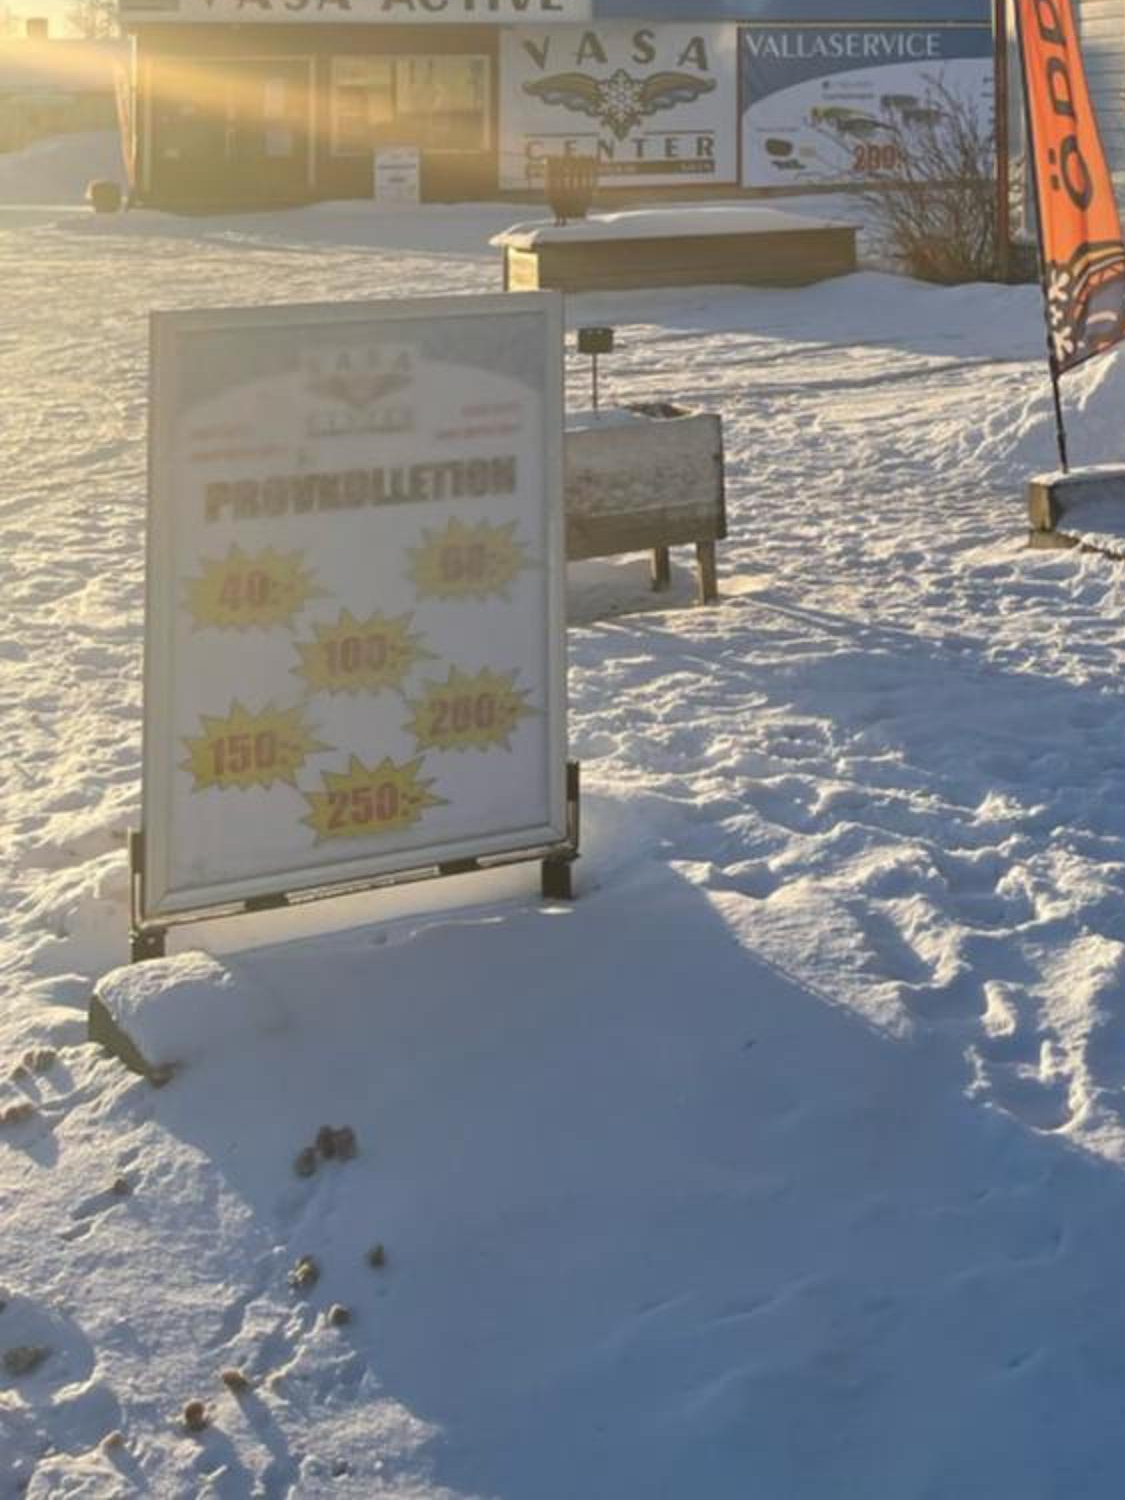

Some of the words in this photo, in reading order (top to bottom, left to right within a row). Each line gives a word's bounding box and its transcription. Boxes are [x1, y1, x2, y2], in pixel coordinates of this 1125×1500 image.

[522, 28, 711, 71] VASA
[745, 32, 943, 58] VALLASERVICE
[525, 136, 716, 161] CENTER
